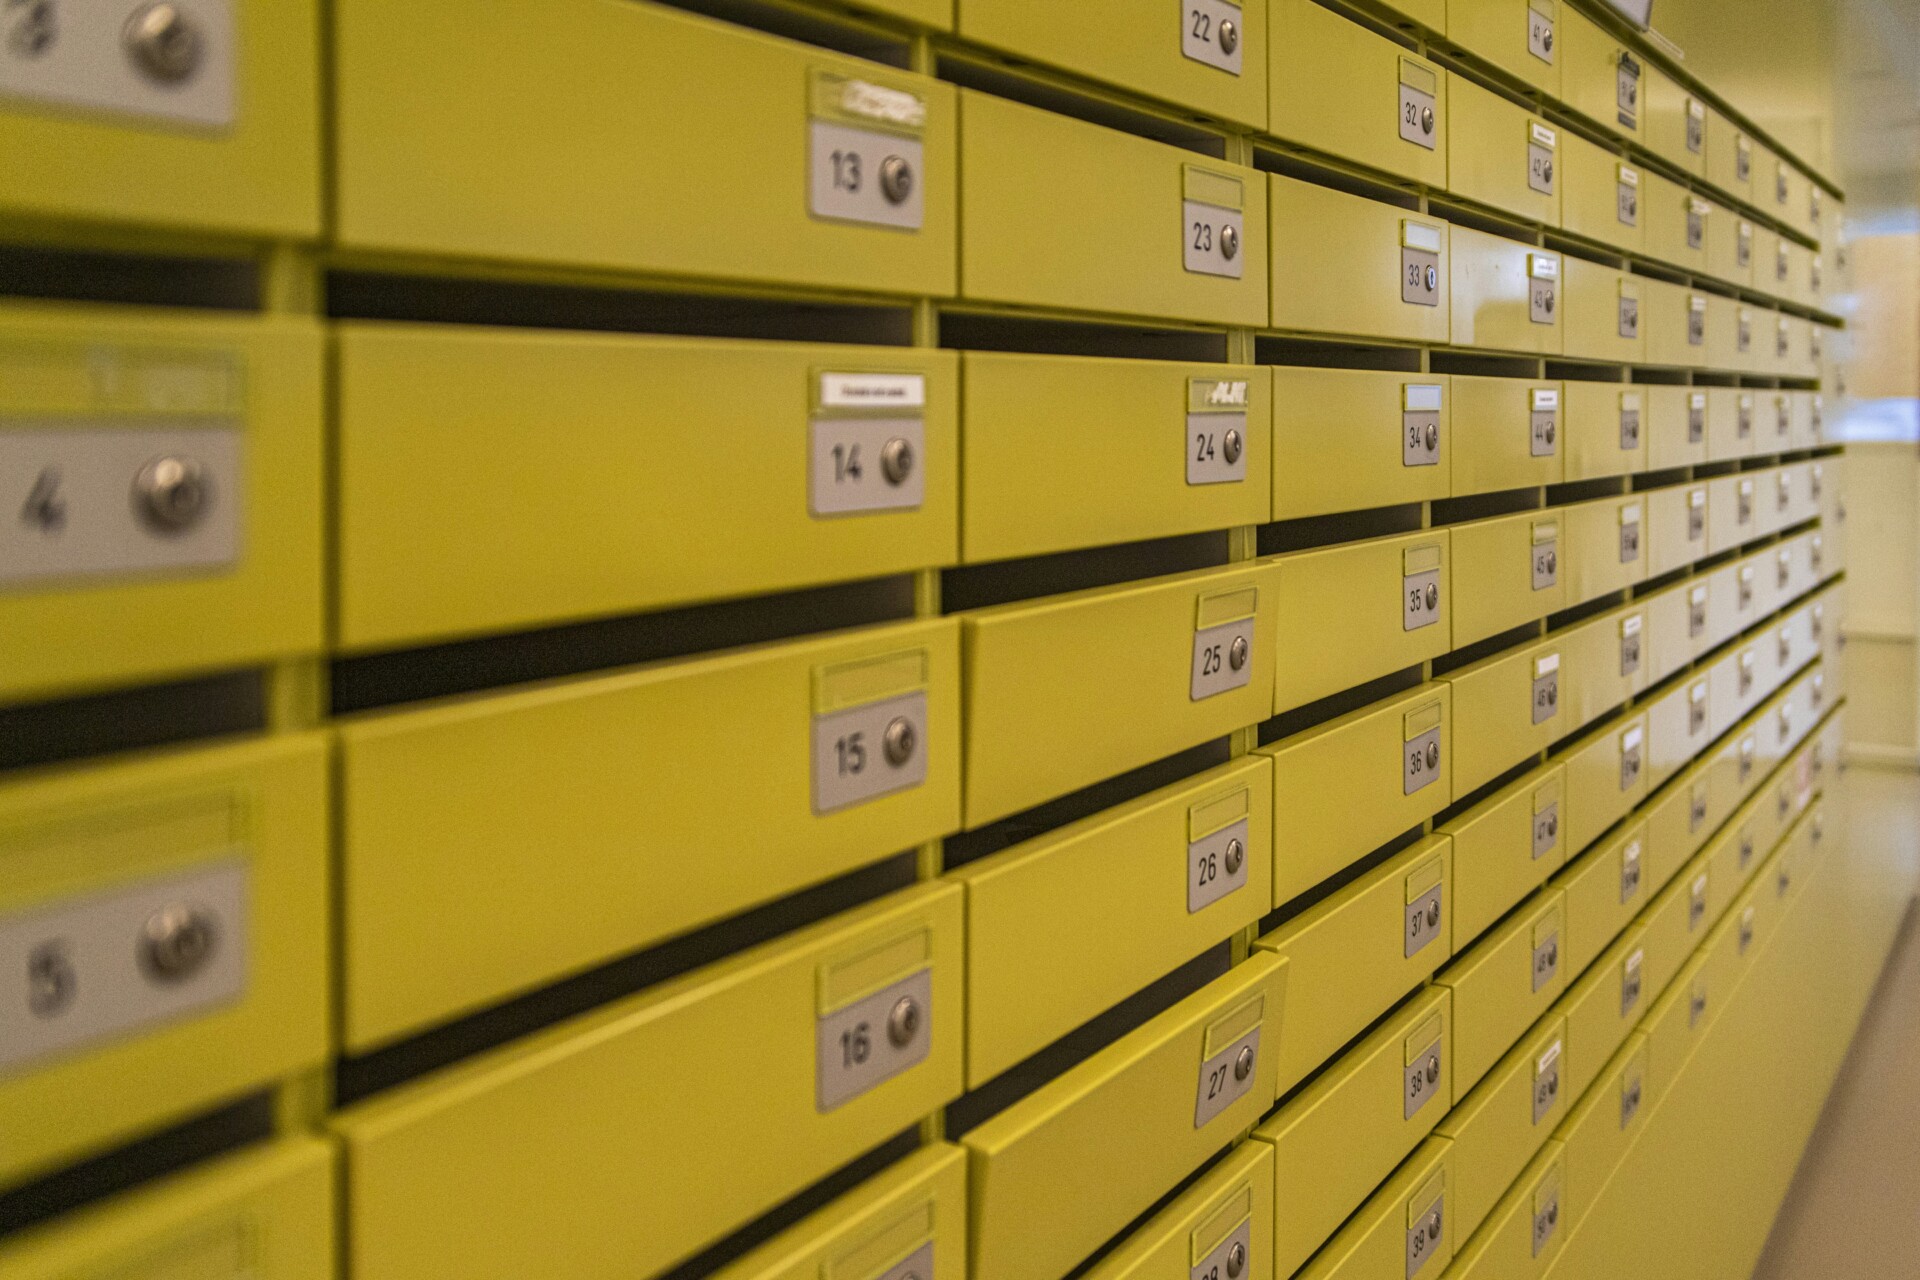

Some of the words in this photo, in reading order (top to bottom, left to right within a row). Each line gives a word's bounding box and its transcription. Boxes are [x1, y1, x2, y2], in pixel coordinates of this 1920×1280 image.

[1192, 10, 1210, 42] 22
[1405, 102, 1416, 126] 32
[830, 149, 863, 193] 13
[1533, 158, 1541, 177] 42
[1193, 222, 1211, 252] 23
[1408, 264, 1420, 286] 33
[1196, 433, 1214, 461] 24
[1410, 427, 1421, 449] 34
[831, 442, 863, 484] 14
[20, 467, 66, 534] 4
[1536, 555, 1545, 574] 45
[1410, 588, 1421, 612] 35
[1203, 645, 1221, 676] 25
[834, 731, 867, 775] 15
[1410, 751, 1422, 775] 36
[1199, 853, 1216, 886] 26
[1411, 910, 1423, 937] 37
[27, 938, 77, 1019] 5
[838, 1021, 871, 1069] 16
[1208, 1063, 1227, 1100] 27
[1411, 1070, 1422, 1097] 38
[1413, 1229, 1424, 1258] 39
